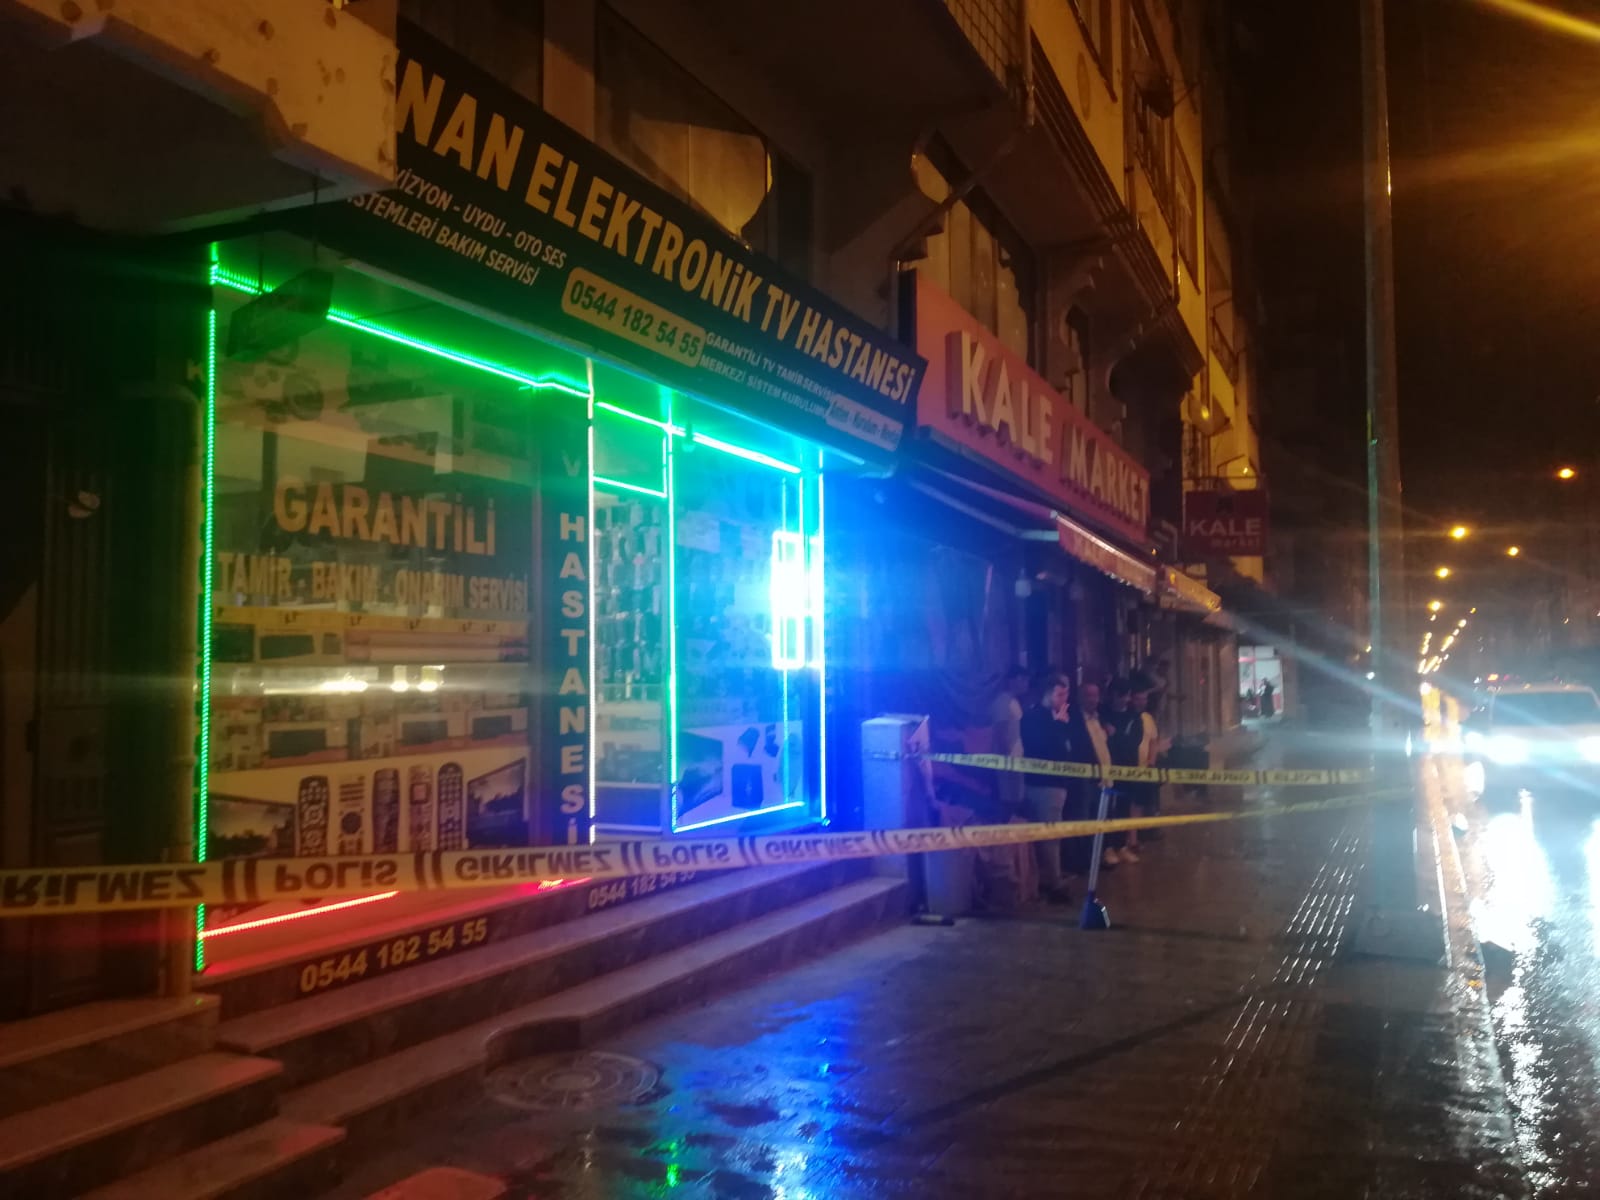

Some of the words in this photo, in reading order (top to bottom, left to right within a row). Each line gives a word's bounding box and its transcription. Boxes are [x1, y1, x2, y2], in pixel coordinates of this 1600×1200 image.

[346, 193, 440, 240] STEMLERİ
[438, 225, 487, 262] BAKIM
[486, 249, 541, 287] SERVİSİ
[462, 203, 506, 238] UYDU
[514, 230, 542, 256] OTO
[541, 244, 567, 269] SES
[569, 280, 617, 321] 0544
[622, 304, 652, 339] 182
[655, 319, 679, 347] 54
[679, 332, 702, 358] 55
[706, 331, 763, 367] GARANTİLİ
[763, 357, 776, 372] TV
[761, 284, 801, 341] TV
[795, 307, 915, 404] HASTANESİ
[700, 354, 747, 382] MERKEZİ
[960, 330, 1053, 464] KALE
[1069, 426, 1148, 527] MARKET
[273, 477, 496, 556] GARANTİLİ
[1190, 517, 1262, 537] KALE
[219, 552, 293, 598] TAMİR
[312, 561, 379, 602] BAKIM
[470, 573, 529, 612] SERVİSİ
[559, 512, 585, 845] HASTANESİ
[588, 880, 627, 909] 0544
[631, 873, 656, 896] 182
[301, 952, 369, 993] 0544
[377, 939, 422, 970] 182
[426, 927, 455, 957] 54
[461, 917, 488, 946] 55
